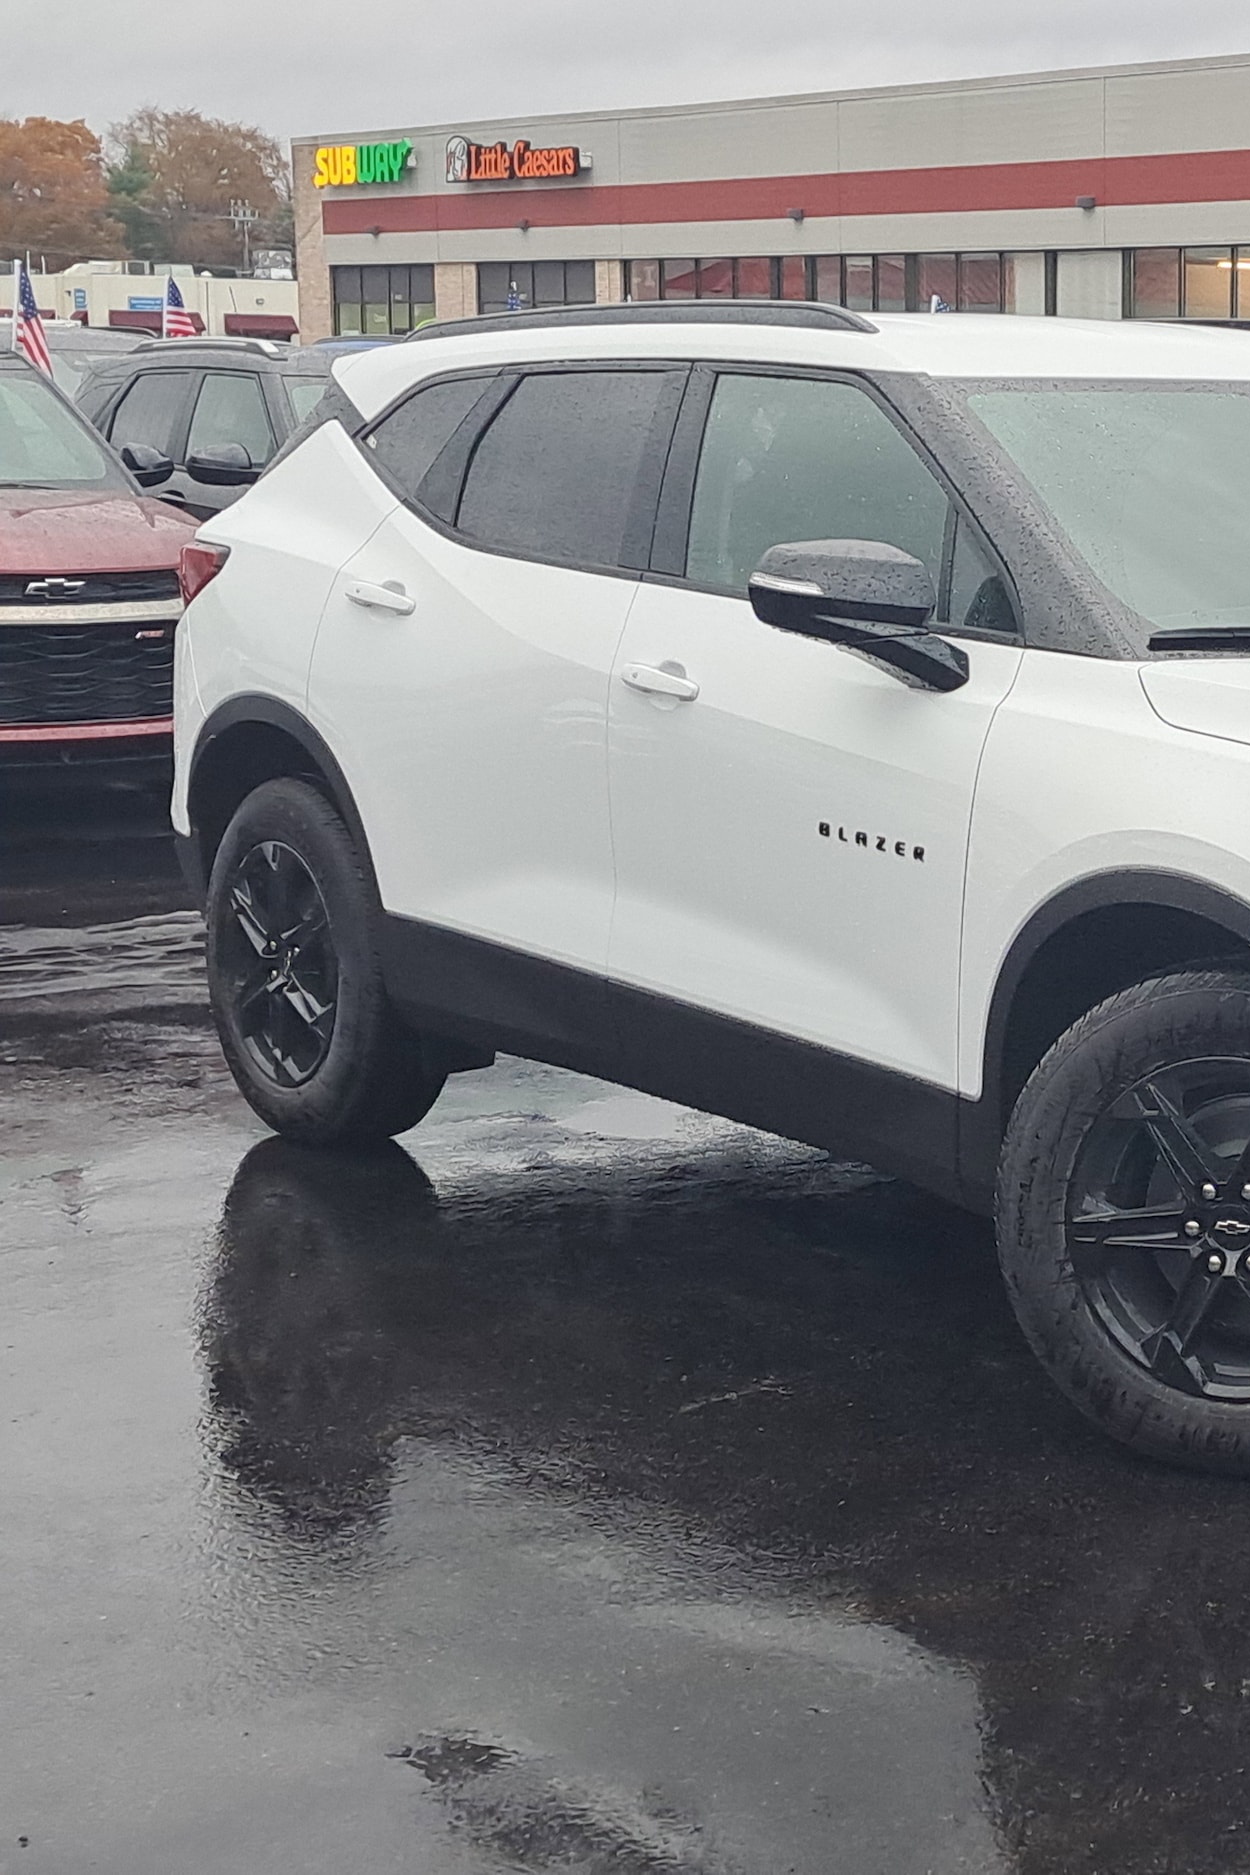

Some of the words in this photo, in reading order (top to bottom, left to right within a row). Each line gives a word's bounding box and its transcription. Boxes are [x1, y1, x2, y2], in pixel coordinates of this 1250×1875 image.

[314, 138, 411, 188] SUBWAY
[469, 142, 510, 180] Little
[513, 140, 575, 178] Caesars
[818, 821, 926, 863] BLAZER
